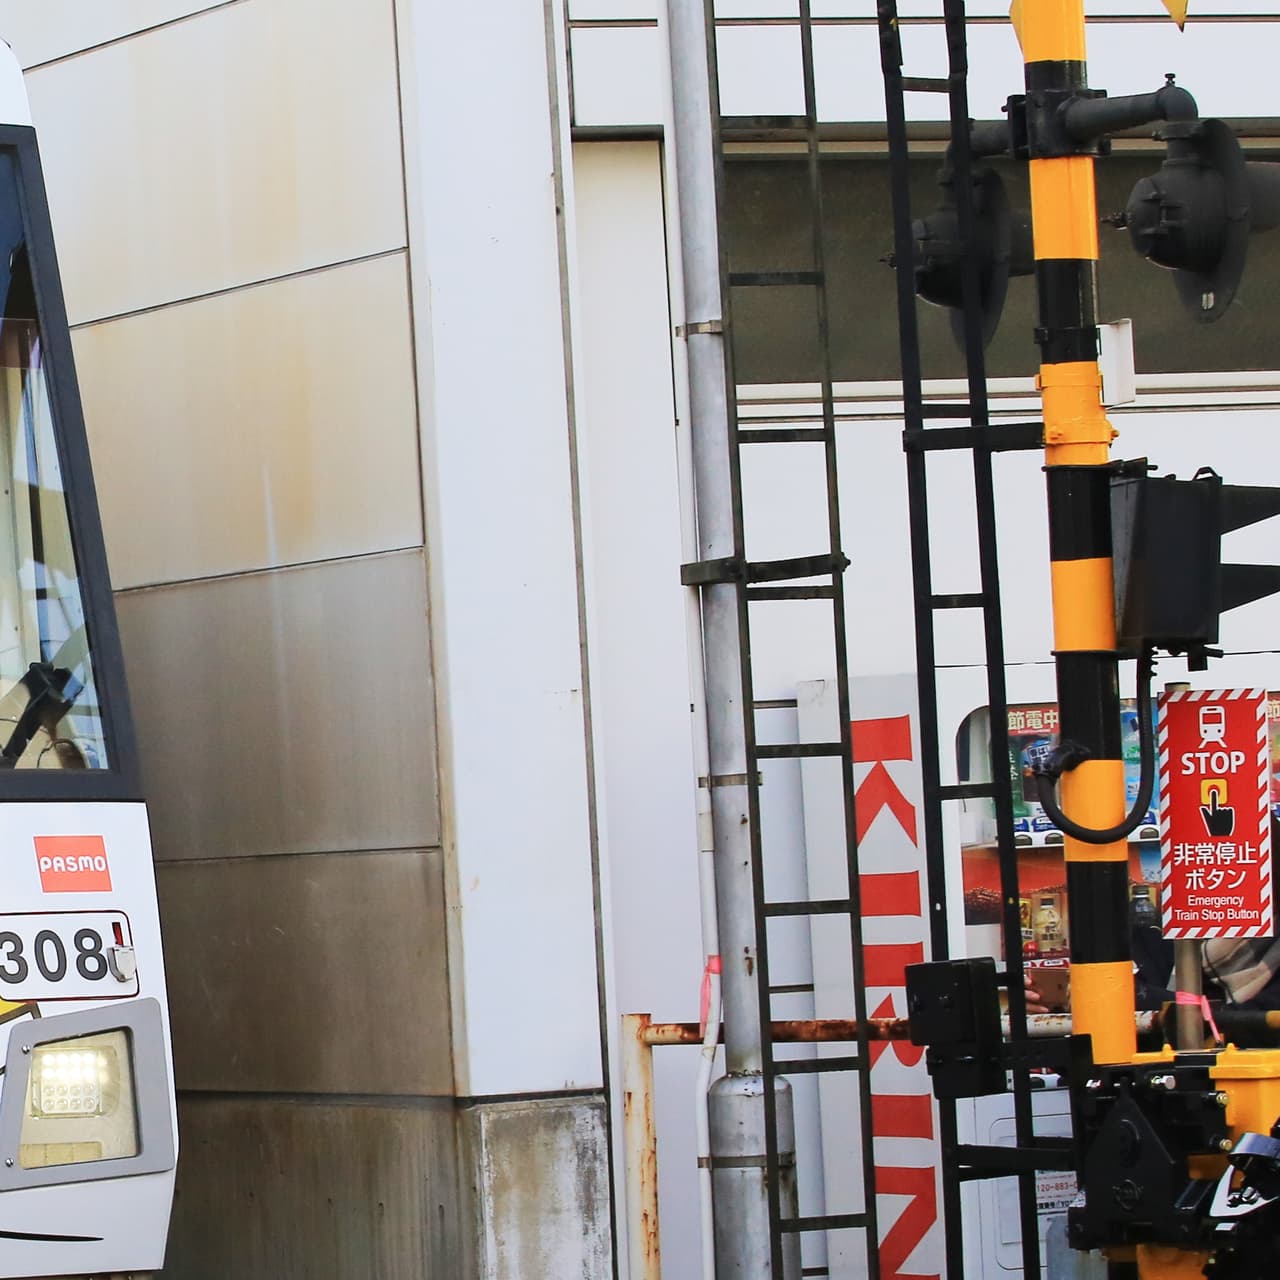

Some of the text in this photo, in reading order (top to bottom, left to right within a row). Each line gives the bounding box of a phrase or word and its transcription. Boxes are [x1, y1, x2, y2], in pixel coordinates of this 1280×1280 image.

[1007, 709, 1059, 730] 節電中
[1180, 751, 1246, 776] STOP
[40, 855, 106, 873] PASMO
[1174, 841, 1258, 866] 非常停止
[1185, 868, 1247, 891] ボタン
[1187, 894, 1245, 909] Emergency
[1175, 907, 1259, 923] Train Stop Button
